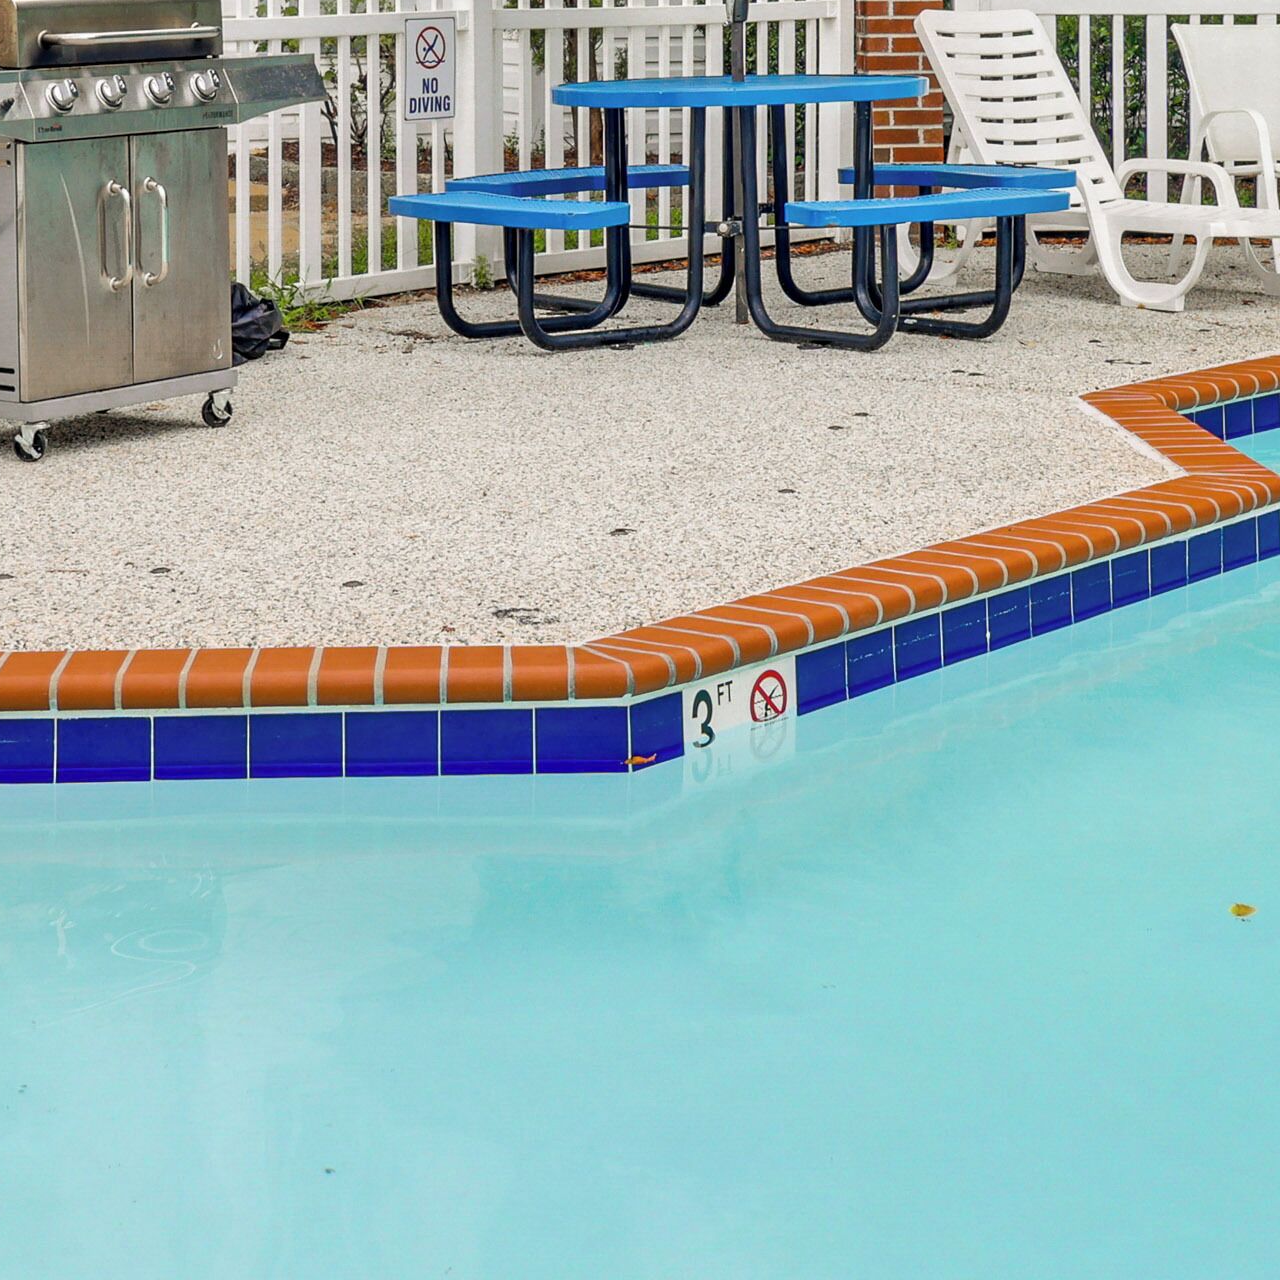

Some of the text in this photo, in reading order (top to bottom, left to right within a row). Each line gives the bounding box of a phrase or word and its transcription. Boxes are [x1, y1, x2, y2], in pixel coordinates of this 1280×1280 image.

[422, 77, 438, 94] NO
[409, 95, 450, 113] DIVING
[692, 680, 733, 748] 3 FT
